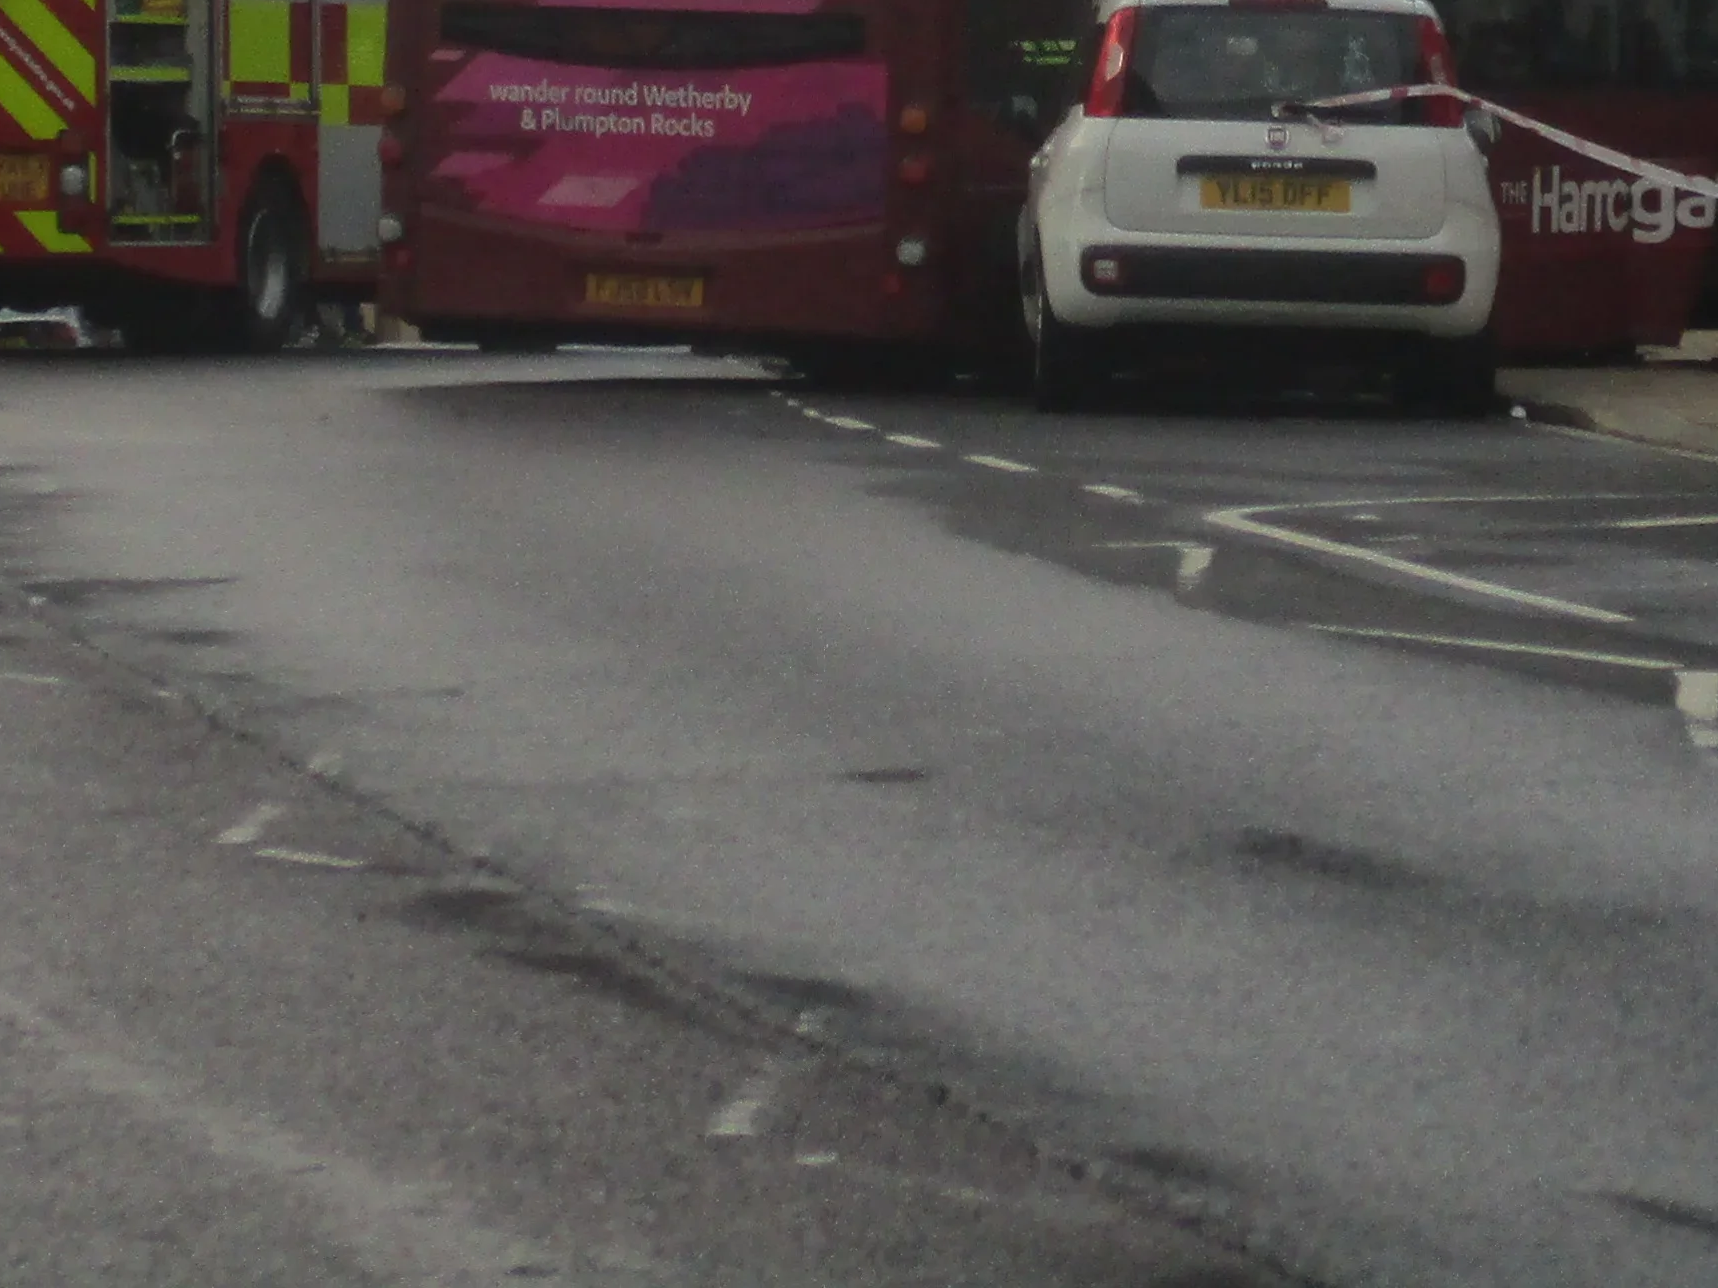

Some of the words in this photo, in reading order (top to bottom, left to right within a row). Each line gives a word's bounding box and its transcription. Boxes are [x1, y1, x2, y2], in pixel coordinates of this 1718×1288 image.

[489, 77, 570, 105] wander
[574, 80, 639, 107] round
[643, 83, 753, 118] Wetherby
[520, 107, 537, 131] &
[540, 106, 646, 139] Plumpton
[651, 112, 717, 139] Rocks
[1500, 181, 1528, 205] THE
